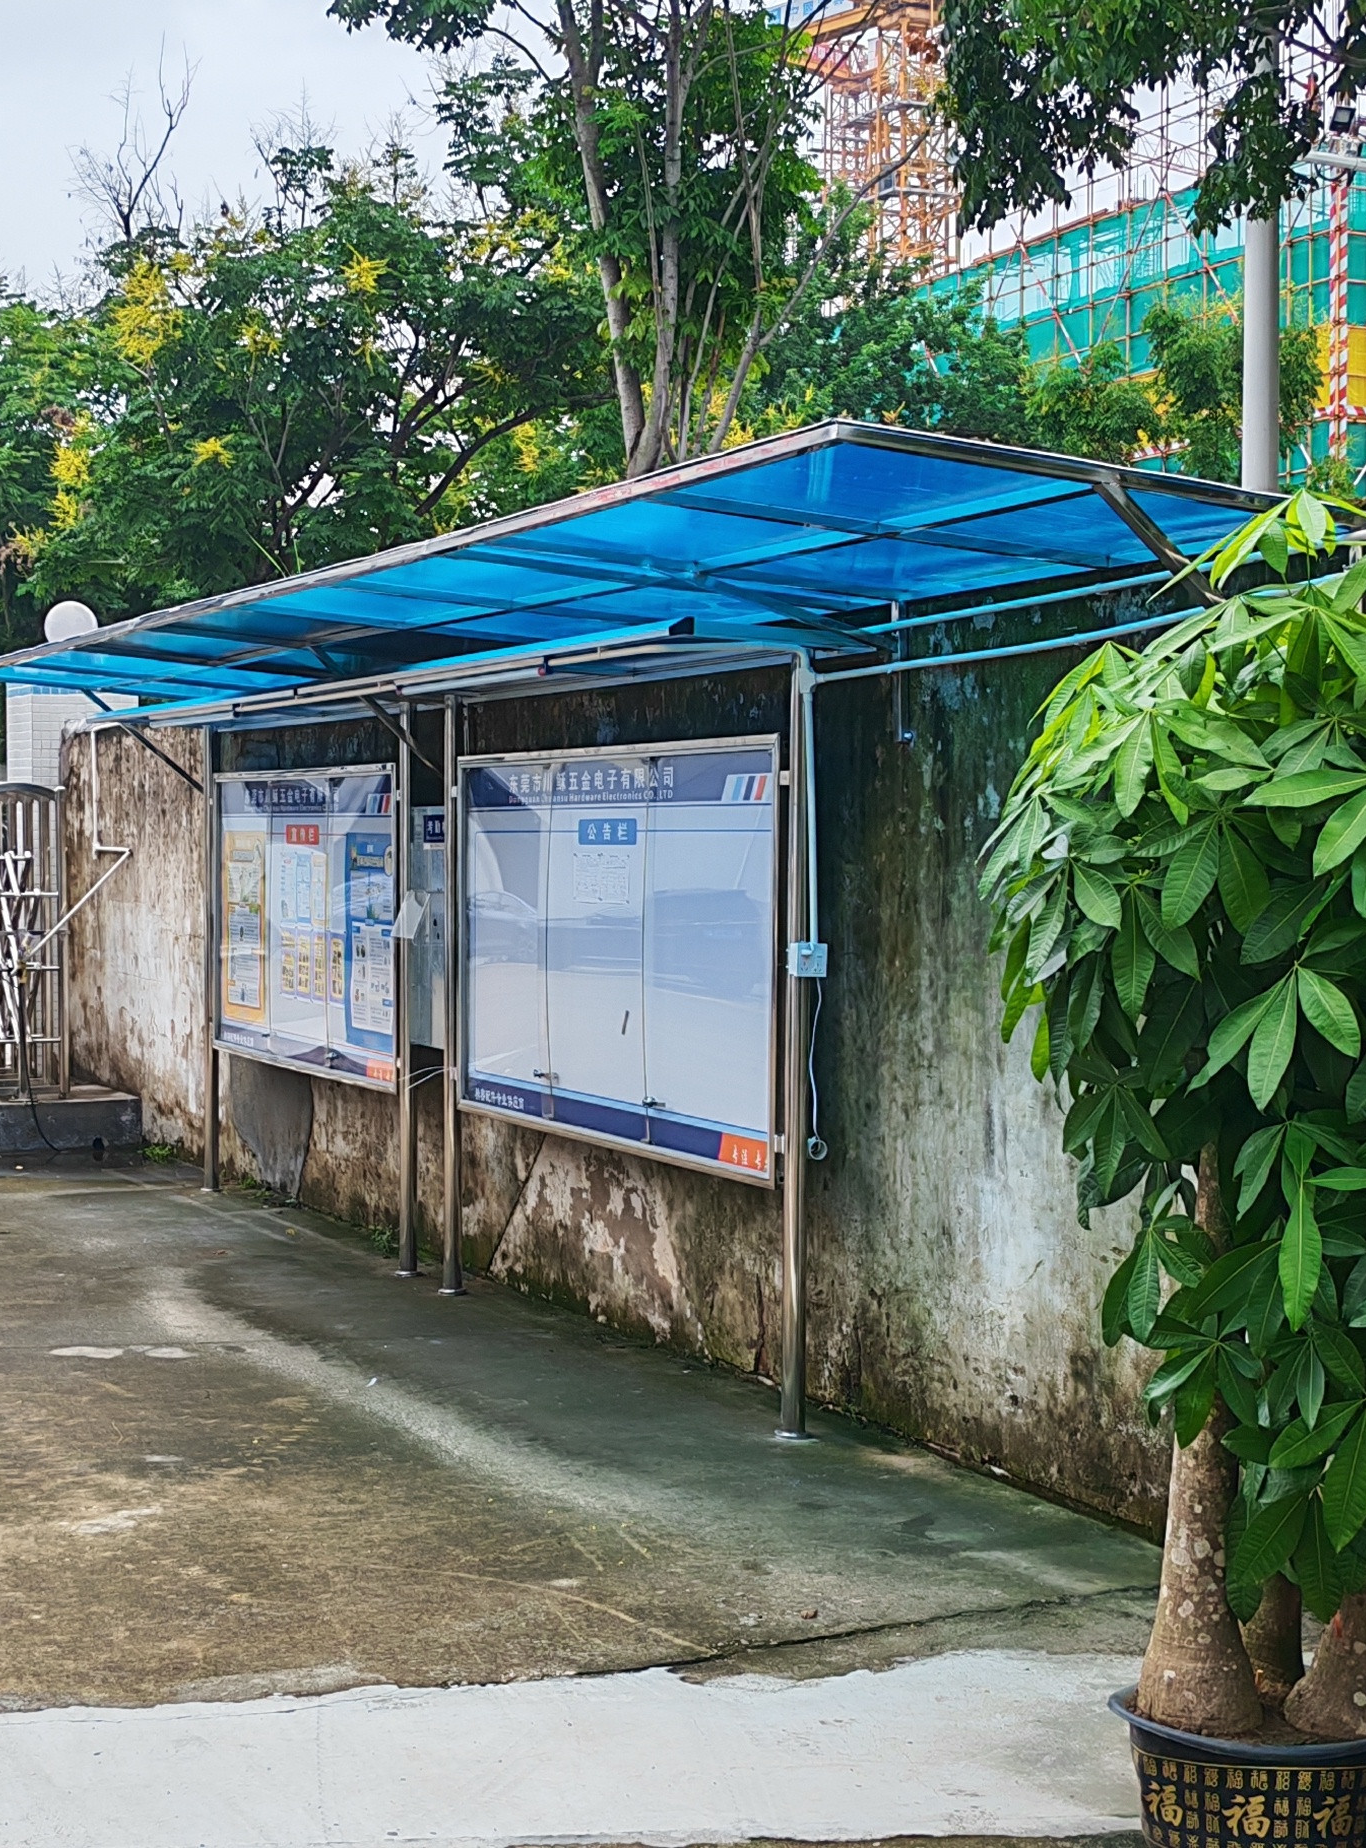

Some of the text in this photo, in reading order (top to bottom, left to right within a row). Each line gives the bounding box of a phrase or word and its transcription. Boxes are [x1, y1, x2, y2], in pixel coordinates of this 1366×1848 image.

[569, 793, 601, 802] Hardware
[603, 791, 642, 800] Electronics
[427, 820, 445, 835] 考勤
[587, 822, 629, 841] 公告栏
[1143, 1781, 1184, 1828] 福
[1221, 1794, 1271, 1839] 福
[1313, 1793, 1355, 1839] 福
